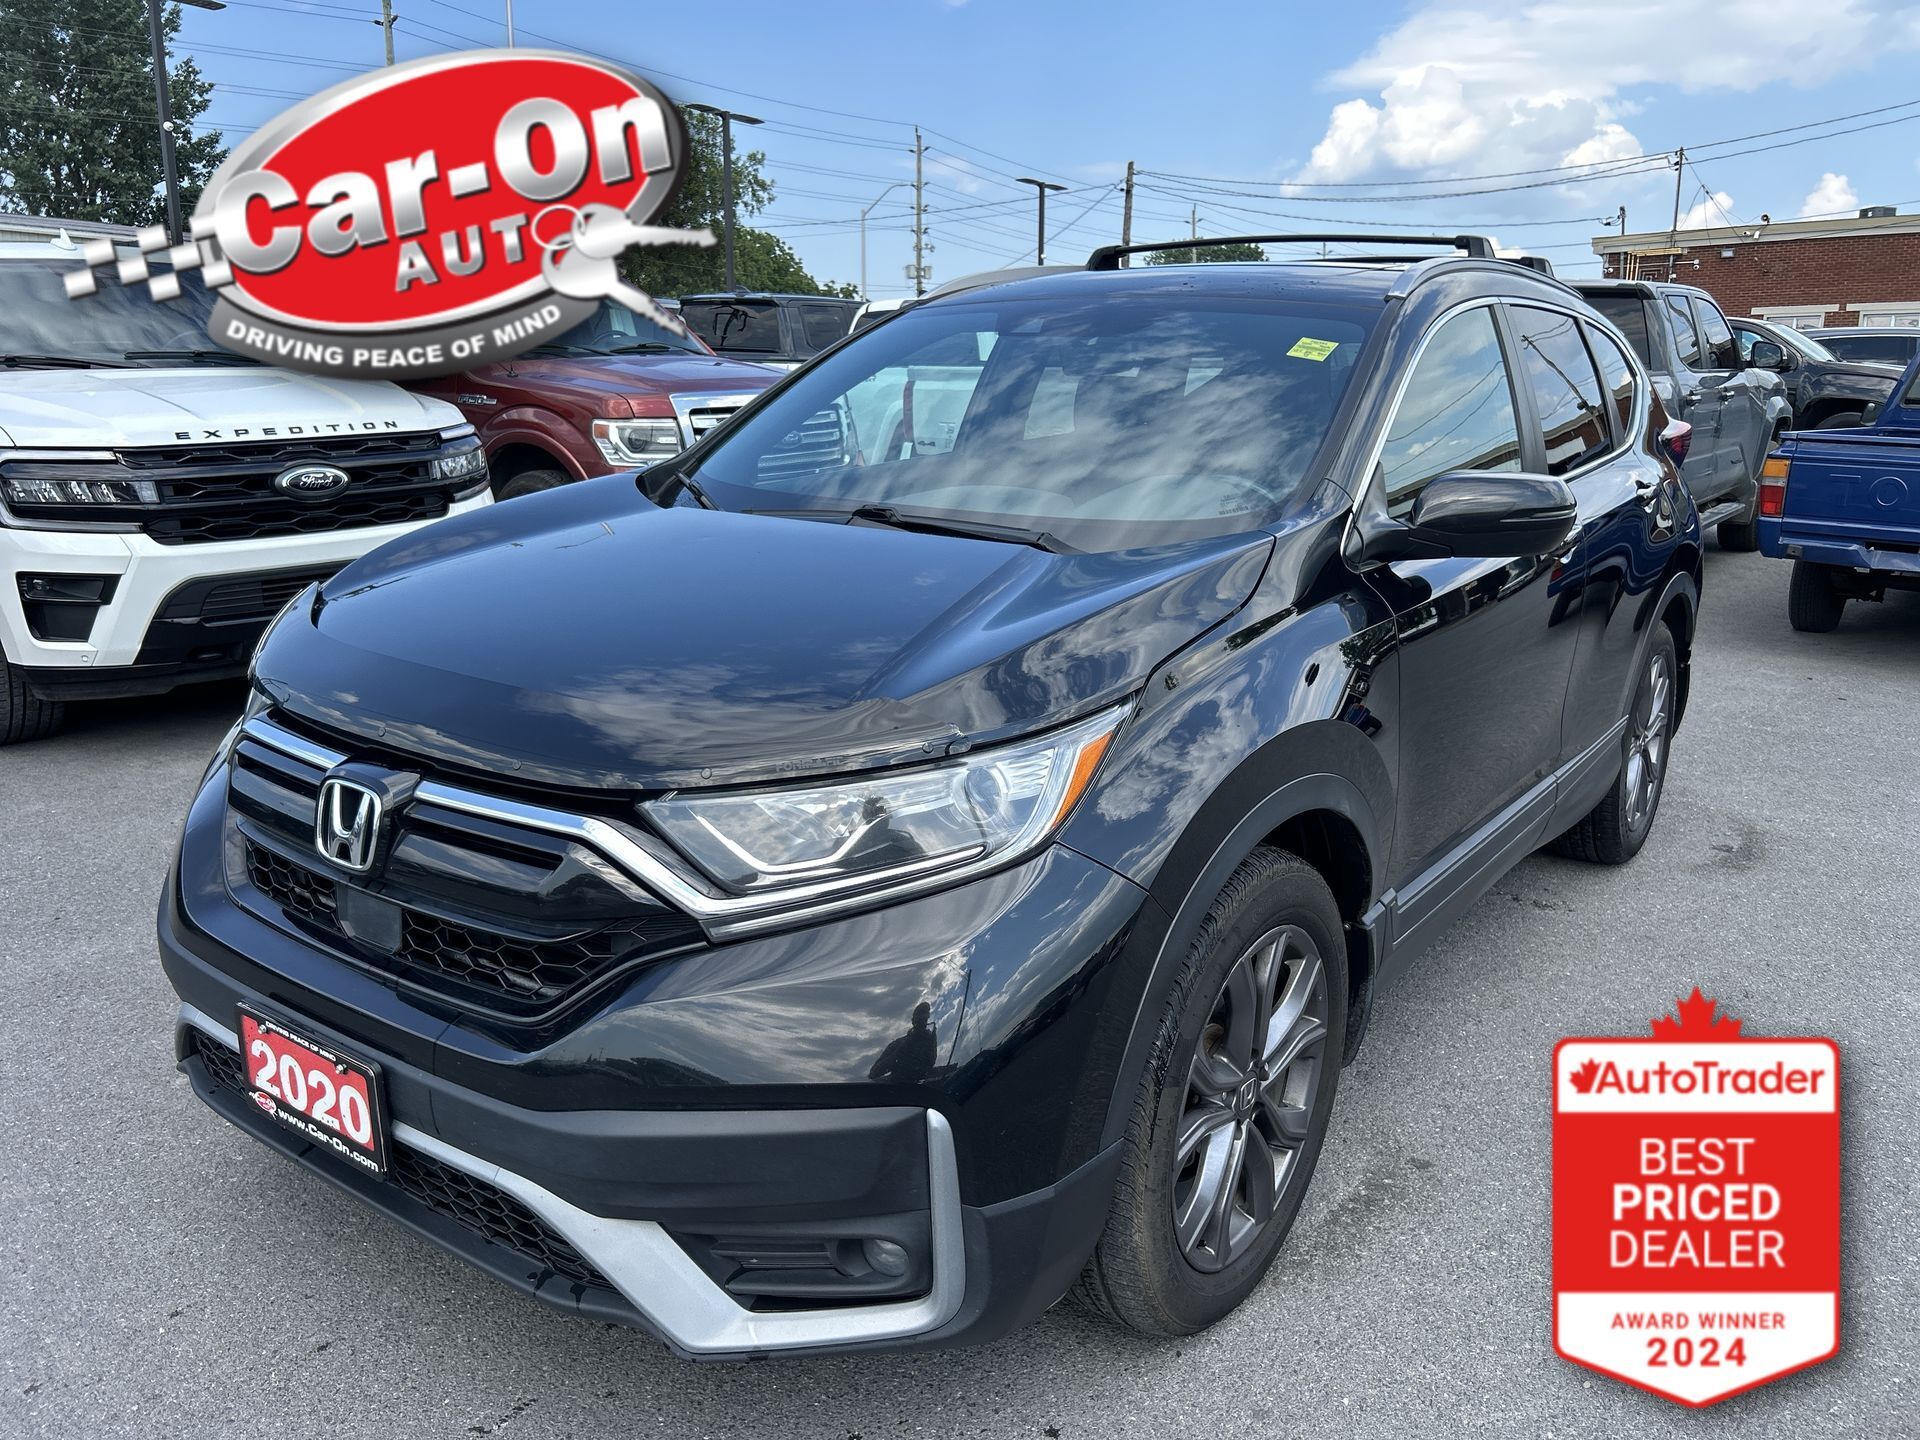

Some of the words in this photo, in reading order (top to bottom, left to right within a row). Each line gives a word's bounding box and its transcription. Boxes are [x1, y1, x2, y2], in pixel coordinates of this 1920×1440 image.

[175, 420, 398, 440] EXPEDITION
[300, 472, 334, 488] Ford
[251, 1039, 371, 1144] 2020
[277, 1108, 379, 1172] www.Car-On.com
